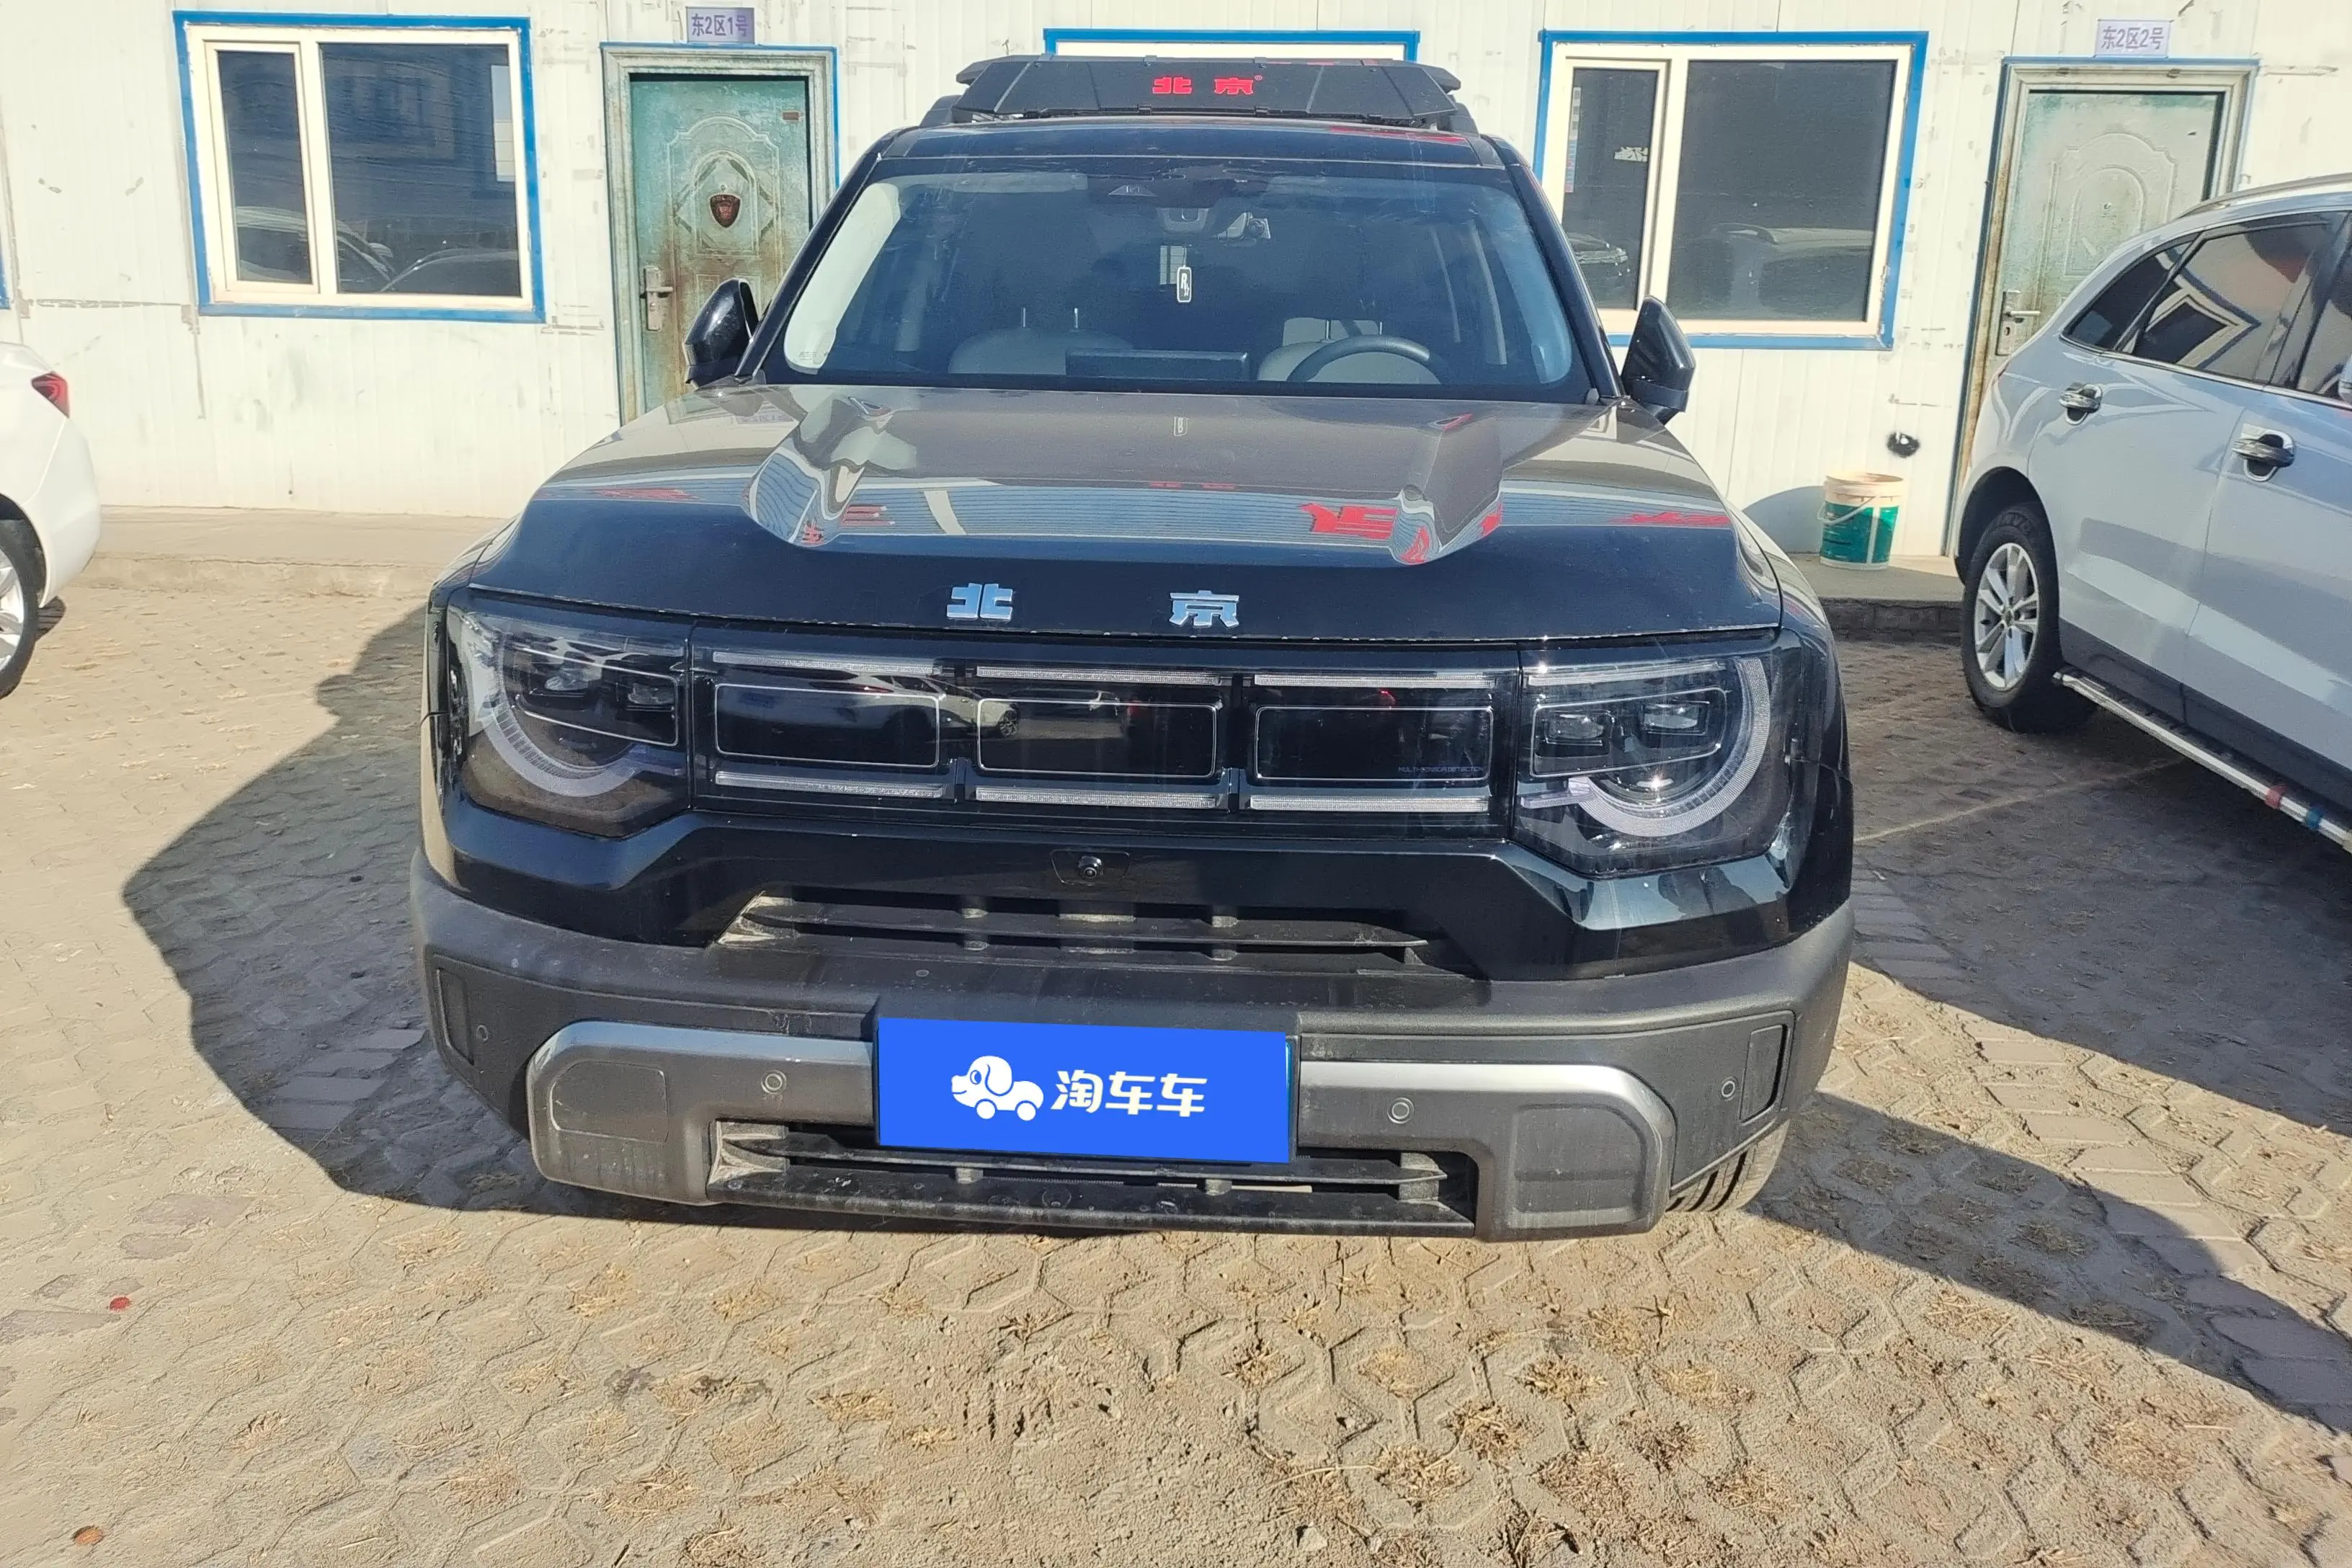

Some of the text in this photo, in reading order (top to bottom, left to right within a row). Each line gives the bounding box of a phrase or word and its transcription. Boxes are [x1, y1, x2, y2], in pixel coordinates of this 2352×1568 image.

[691, 14, 749, 37] 东2区1号
[2101, 25, 2165, 50] 东2区2号
